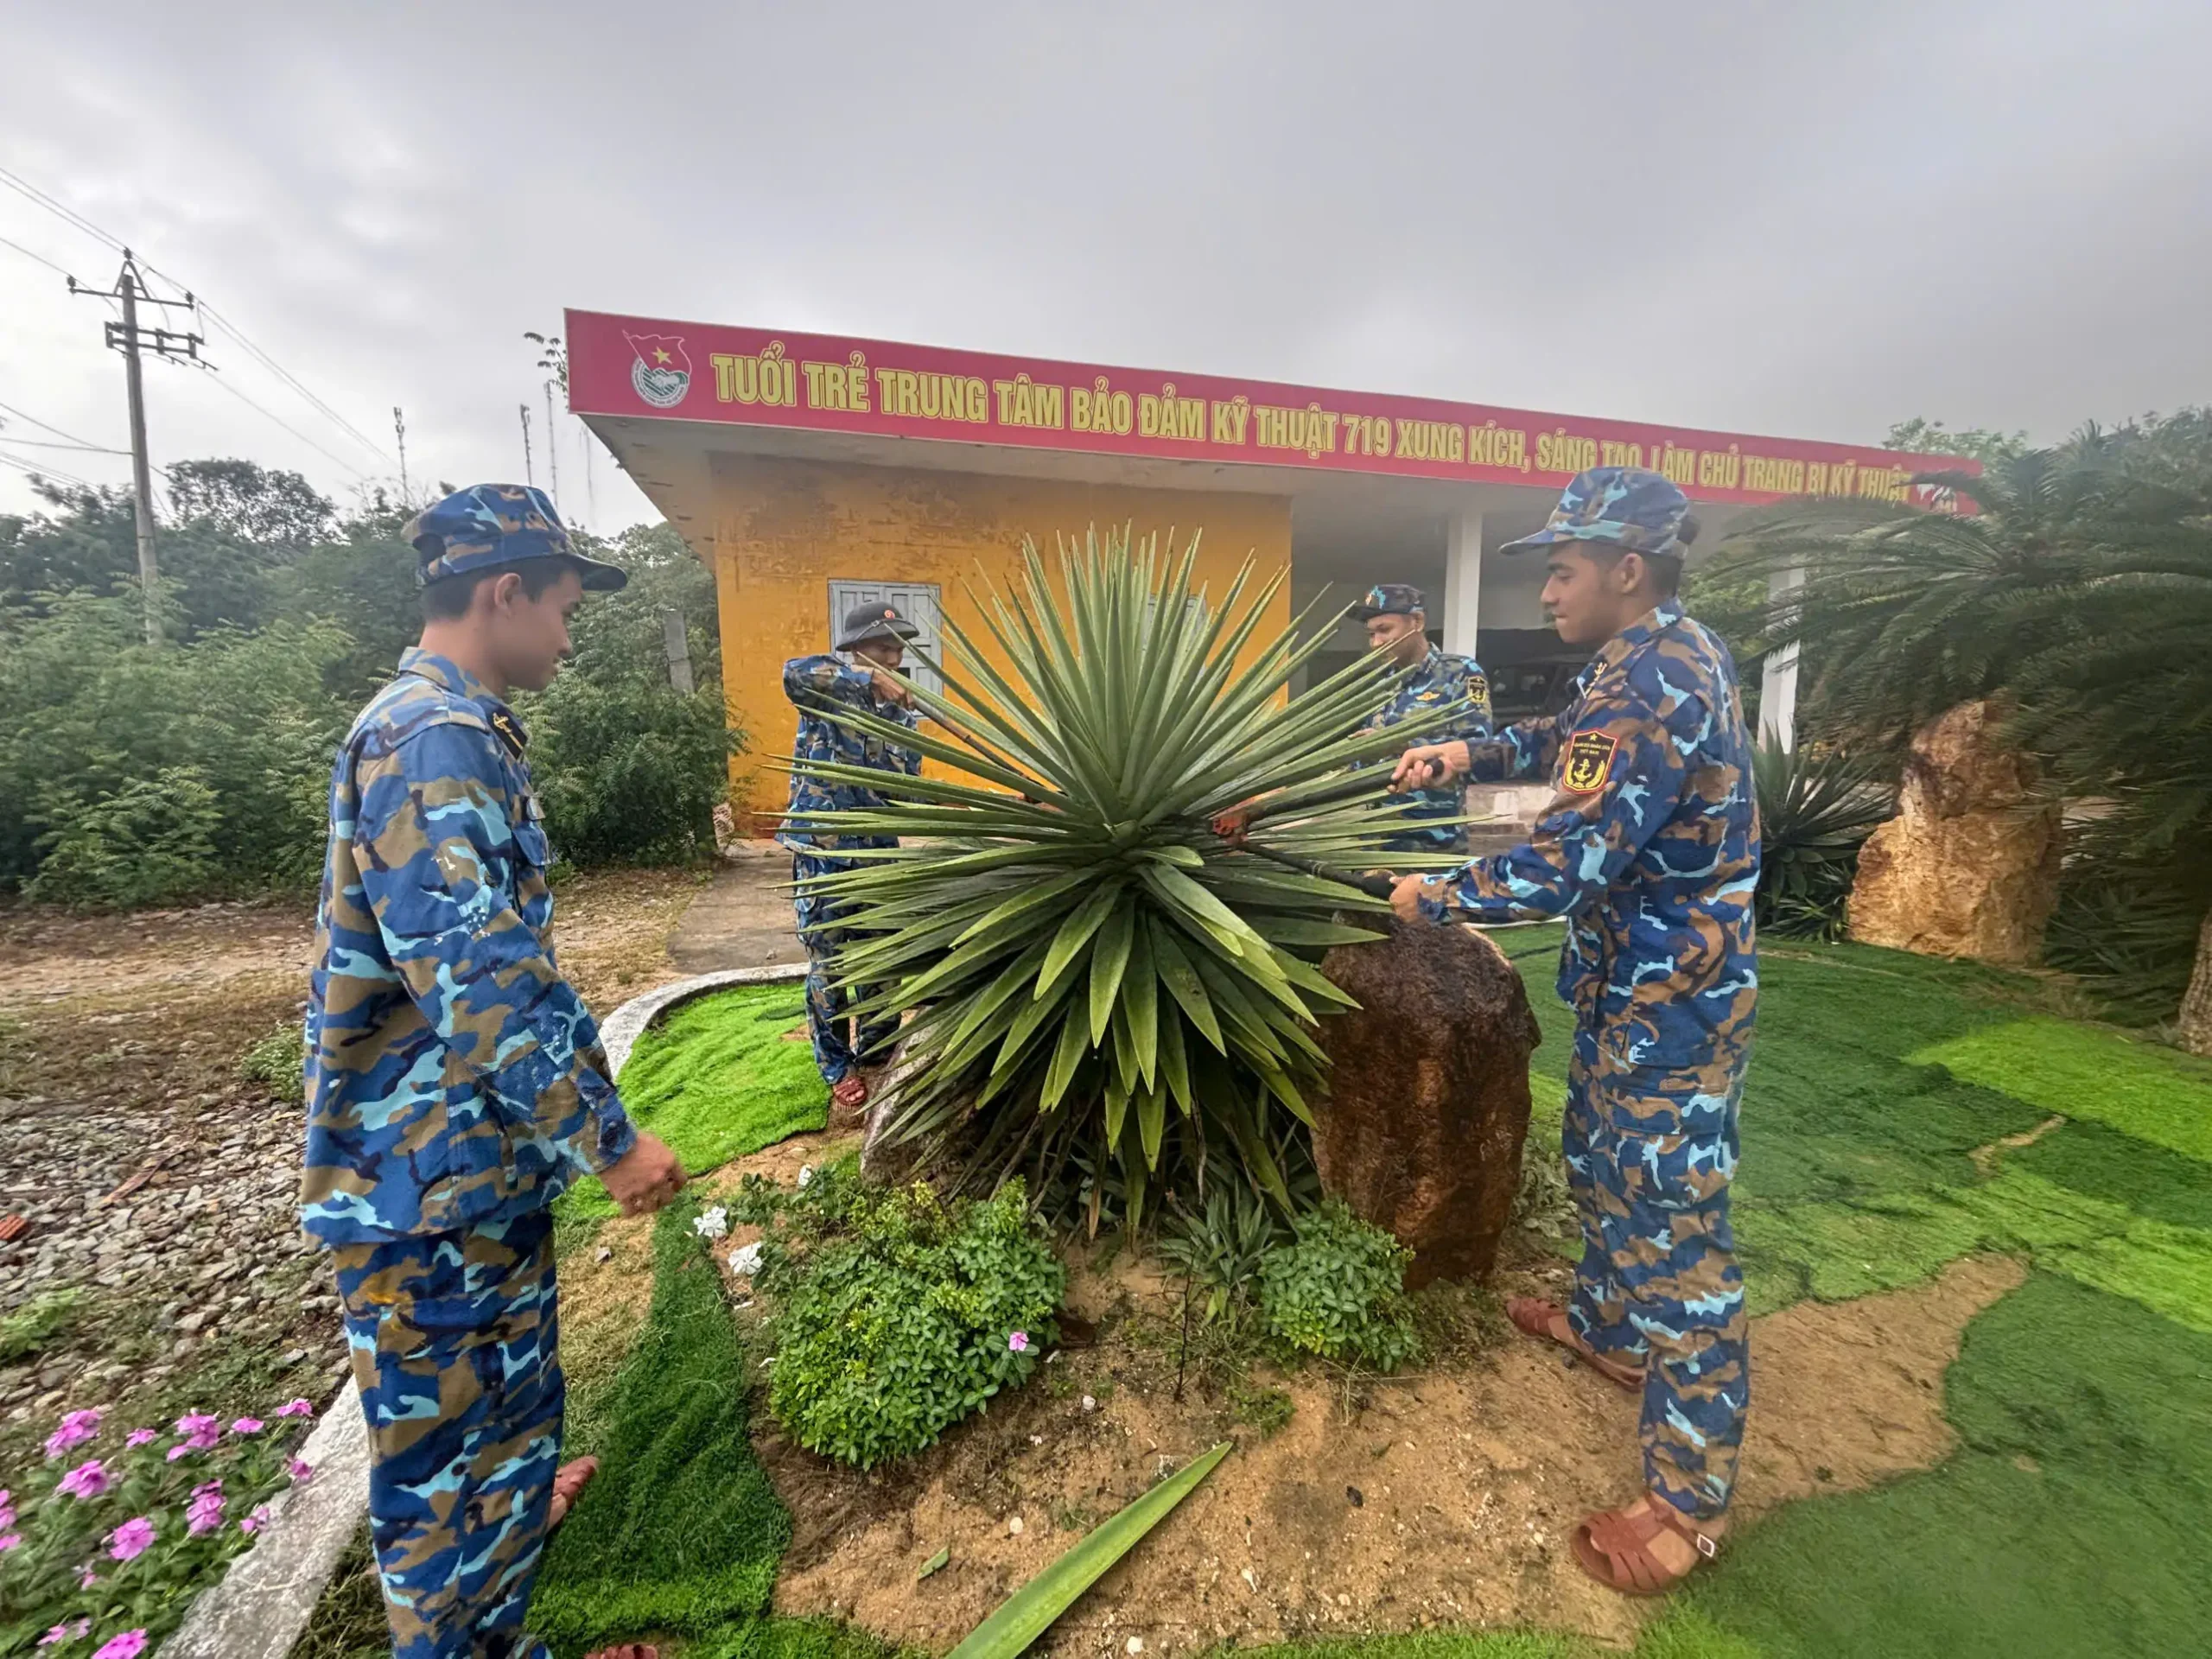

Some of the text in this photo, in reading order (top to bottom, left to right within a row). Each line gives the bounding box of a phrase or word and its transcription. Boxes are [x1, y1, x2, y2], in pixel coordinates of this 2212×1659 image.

[710, 340, 796, 407] TUỔI
[803, 351, 870, 412] TRẺ
[875, 368, 988, 423] TRUNG
[994, 373, 1064, 430] TÂM
[1070, 376, 1133, 435] BẢO
[1138, 383, 1205, 442] ĐẢM
[1211, 395, 1250, 445] KỸ
[1254, 402, 1338, 459] THUẬT
[1342, 414, 1391, 456] 719
[1395, 418, 1464, 462] XUNG
[1469, 420, 1531, 473] KÍCH,
[1535, 428, 1597, 474] SÁNG
[1698, 443, 1741, 489] CHỦ
[1742, 454, 1804, 494] TRANG
